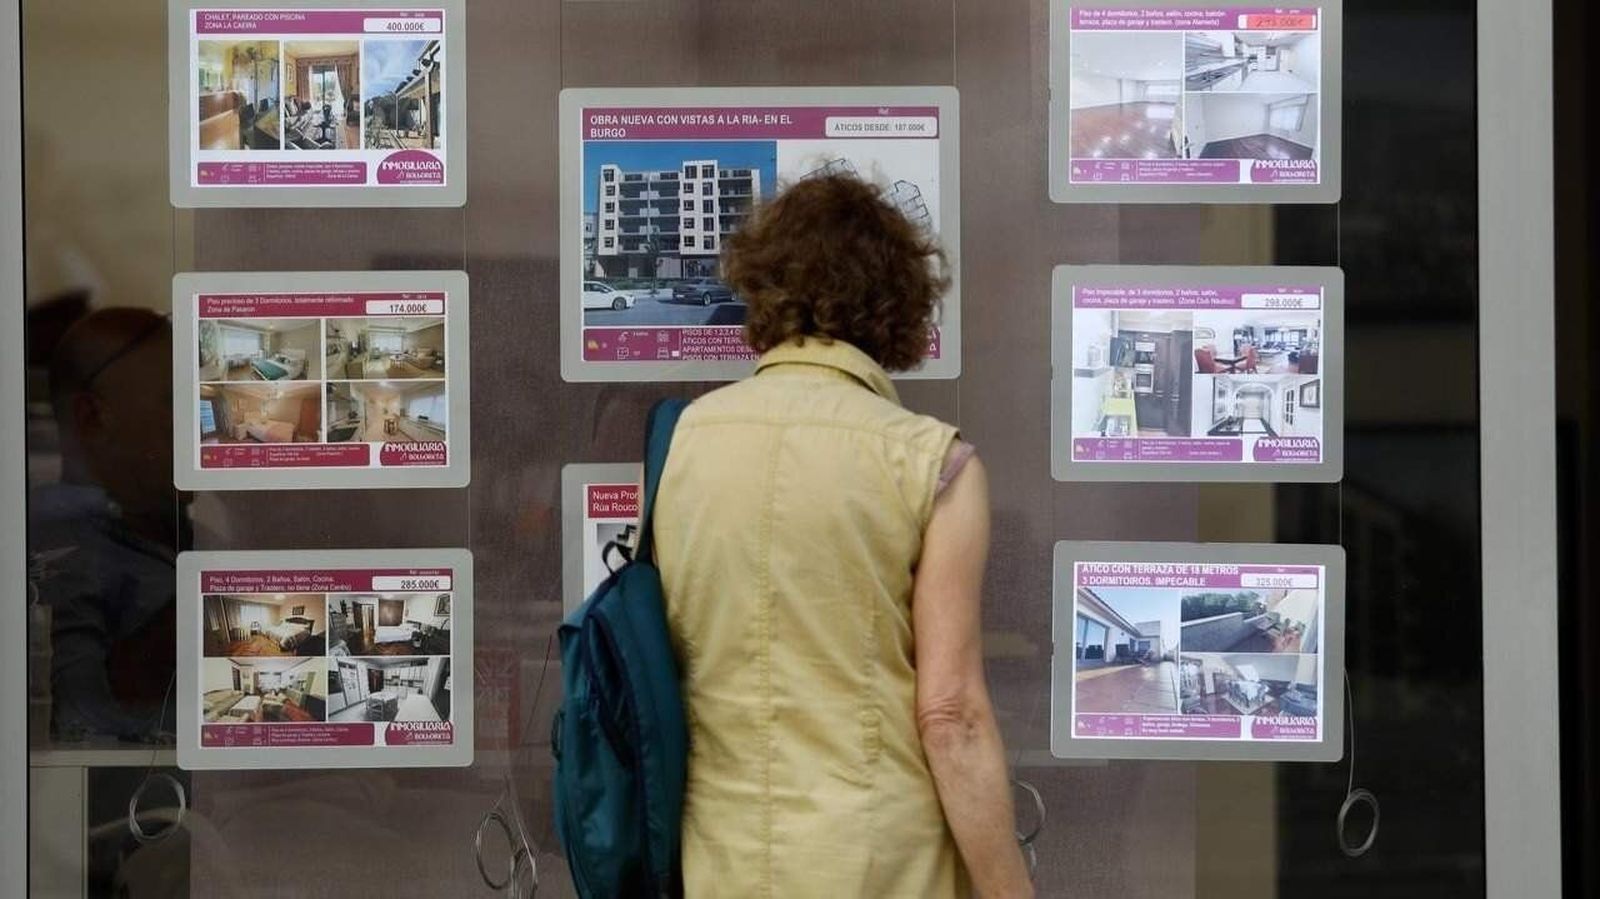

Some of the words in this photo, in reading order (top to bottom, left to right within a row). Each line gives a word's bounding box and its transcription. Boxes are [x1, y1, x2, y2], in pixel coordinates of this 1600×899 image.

[232, 13, 263, 21] PAREADO
[264, 13, 279, 21] CON
[386, 22, 425, 31] 400.000€
[590, 115, 618, 125] OBRA
[620, 115, 654, 125] NUEVA
[657, 115, 678, 125] CON
[680, 115, 714, 125] VISTAS
[716, 115, 725, 125] A
[726, 115, 740, 125] LA
[764, 115, 779, 125] EN
[780, 115, 793, 125] EL
[590, 128, 627, 138] BURGO
[389, 304, 427, 312] 174.000€
[593, 490, 619, 500] Nueva
[1111, 564, 1131, 574] CON
[1134, 564, 1174, 574] TERRAZA
[1176, 564, 1189, 574] DE
[1202, 564, 1239, 574] METROS
[400, 580, 440, 589] 285.000€
[1081, 576, 1088, 586] 3
[1154, 576, 1206, 586] IMPECABLE
